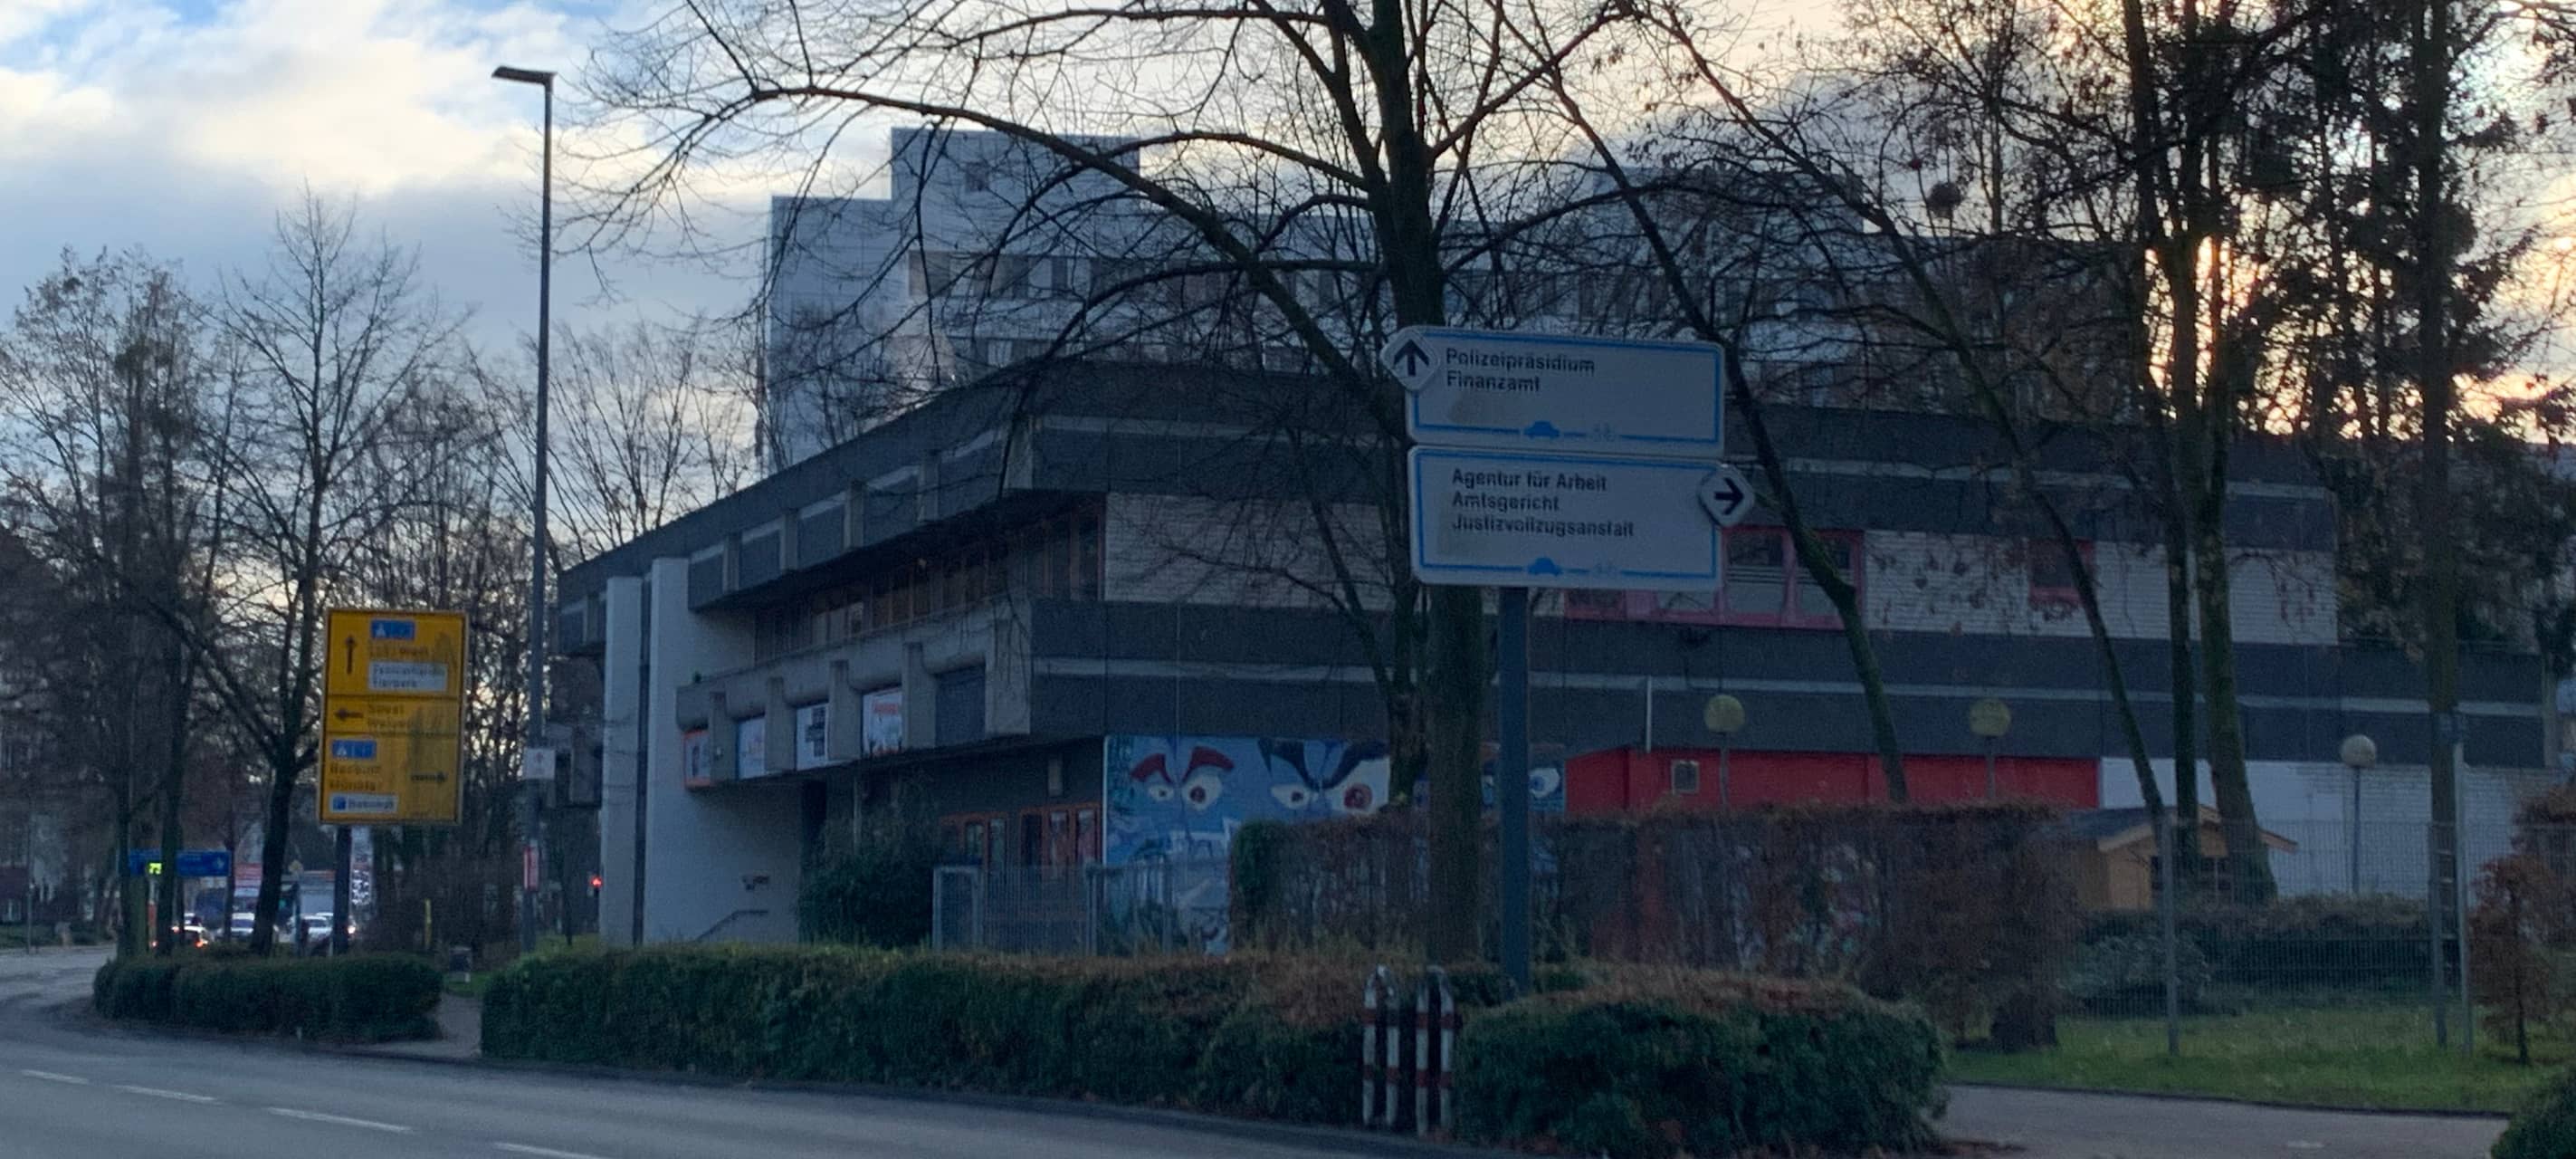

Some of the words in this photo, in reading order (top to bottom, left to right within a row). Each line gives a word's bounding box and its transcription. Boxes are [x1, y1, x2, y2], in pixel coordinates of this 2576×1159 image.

[1446, 347, 1596, 376] Polizeipräsidium
[1447, 370, 1541, 393] Finanzamt
[1452, 467, 1521, 489] Agentur
[1527, 470, 1550, 489] für
[1556, 473, 1608, 492] Arbeit
[1452, 491, 1560, 512] Amtsgericht
[1452, 513, 1635, 538] Justizvollzugsanstalt
